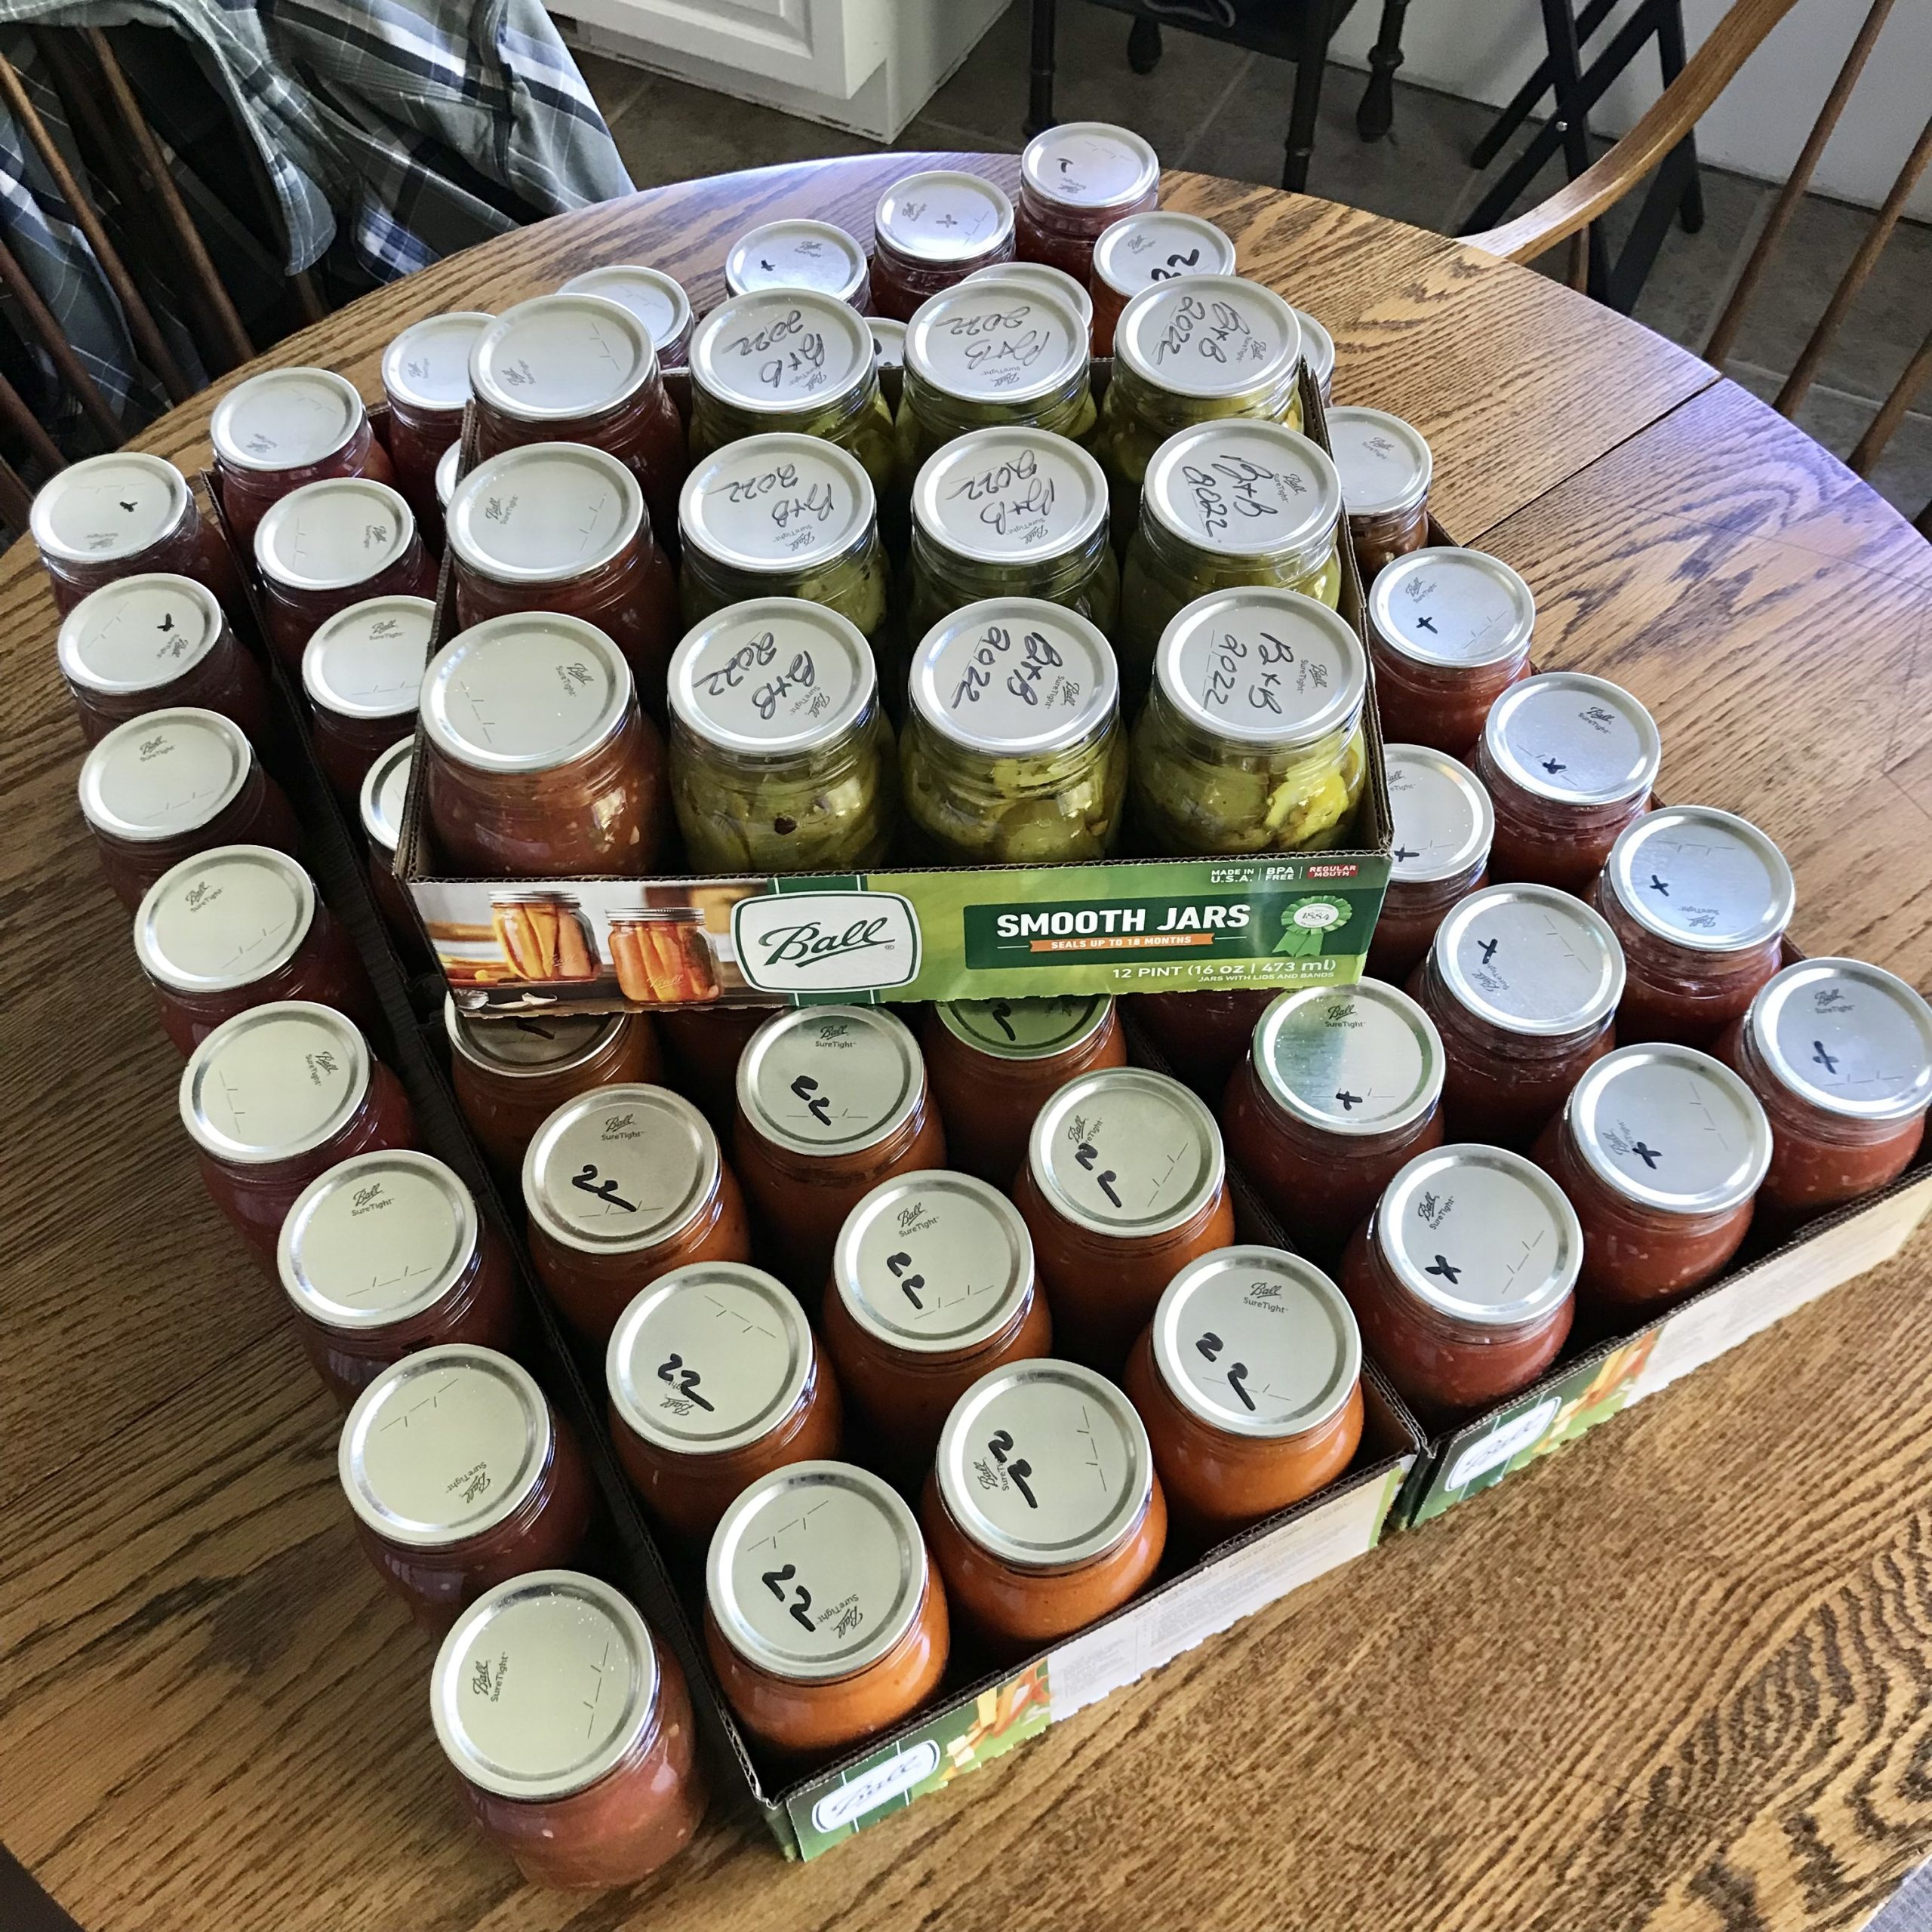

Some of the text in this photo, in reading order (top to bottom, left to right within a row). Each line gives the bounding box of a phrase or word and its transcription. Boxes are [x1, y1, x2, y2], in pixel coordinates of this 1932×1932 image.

[724, 310, 804, 357] 2022
[936, 306, 1032, 337] 2022
[1156, 297, 1205, 366] 2022
[1237, 336, 1253, 364] SureTight
[1250, 340, 1266, 361] Ball
[802, 371, 826, 392] Ball
[983, 367, 1021, 376] SureTight
[991, 373, 1020, 387] Ball
[1362, 441, 1389, 460] SureTight
[1370, 438, 1395, 451] Ball
[706, 463, 798, 503] 2022
[946, 449, 1038, 500] 2022
[1283, 473, 1307, 495] Ball
[1274, 474, 1288, 503] SureTight
[485, 497, 503, 520] Ball
[500, 494, 518, 525] SureTight
[1183, 466, 1228, 538] 2022
[774, 525, 813, 543] SureTight
[1008, 518, 1046, 534] SureTight
[1019, 525, 1048, 544] Ball
[786, 531, 815, 552] Ball
[369, 632, 405, 641] SureTight
[567, 663, 595, 687] Ball
[694, 632, 777, 696] 2022
[952, 626, 1011, 709] 2022
[1204, 634, 1247, 705] 2022
[1309, 664, 1328, 688] Ball
[555, 666, 577, 697] SureTight
[1297, 660, 1309, 694] SureTight
[789, 686, 821, 715] SureTight
[1044, 675, 1065, 709] SureTight
[1060, 681, 1080, 706] Ball
[804, 692, 831, 718] Ball
[1587, 706, 1615, 724] Ball
[1578, 712, 1611, 734] SureTight
[1387, 770, 1404, 785] all
[1390, 783, 1416, 792] eTight
[1211, 875, 1253, 883] U.S.A.
[186, 881, 211, 906] Ball
[190, 888, 224, 913] SureTight
[996, 904, 1251, 937] SMOOTH JARS
[1681, 906, 1720, 915] SureTight
[1687, 915, 1716, 928] Ball
[758, 916, 896, 968] Ball
[1051, 936, 1192, 950] SEALS UP TO 18 MONTHS
[1112, 968, 1131, 979] 12
[1138, 966, 1183, 977] PINT
[1187, 964, 1214, 976] (16
[1262, 961, 1295, 972] 473
[1300, 959, 1337, 971] ml)
[1472, 969, 1500, 992] Ball
[1487, 962, 1509, 990] SureTigh
[1815, 989, 1845, 1006] Ball
[1815, 1004, 1855, 1014] SureTight
[1327, 1004, 1357, 1020] Ball
[815, 1041, 857, 1049] SureTight
[820, 1025, 850, 1041] Ball
[306, 1054, 321, 1086] SureTight
[315, 1051, 338, 1075] Ball
[605, 1114, 635, 1132] Ball
[1068, 1115, 1088, 1143] Ball
[1085, 1117, 1103, 1144] reTight
[601, 1131, 645, 1141] SureTight
[1603, 1131, 1631, 1155] Ball
[353, 1183, 383, 1206] Ball
[1418, 1191, 1440, 1222] Ball
[352, 1198, 395, 1216] SureTight
[897, 1202, 928, 1227] Ball
[1429, 1196, 1456, 1230] SureTight
[899, 1217, 940, 1238] SureTight
[1251, 1282, 1282, 1299] Ball
[1244, 1297, 1289, 1313] SureTight
[660, 1394, 694, 1416] Ball
[447, 1462, 487, 1494] SureTight
[973, 1457, 998, 1490] Ball
[997, 1461, 1009, 1491] SureTi
[460, 1472, 491, 1503] Ball
[817, 1594, 859, 1625] SureTight
[833, 1606, 863, 1640] Ball
[473, 1660, 492, 1695] Ball
[491, 1652, 509, 1702] SureTight
